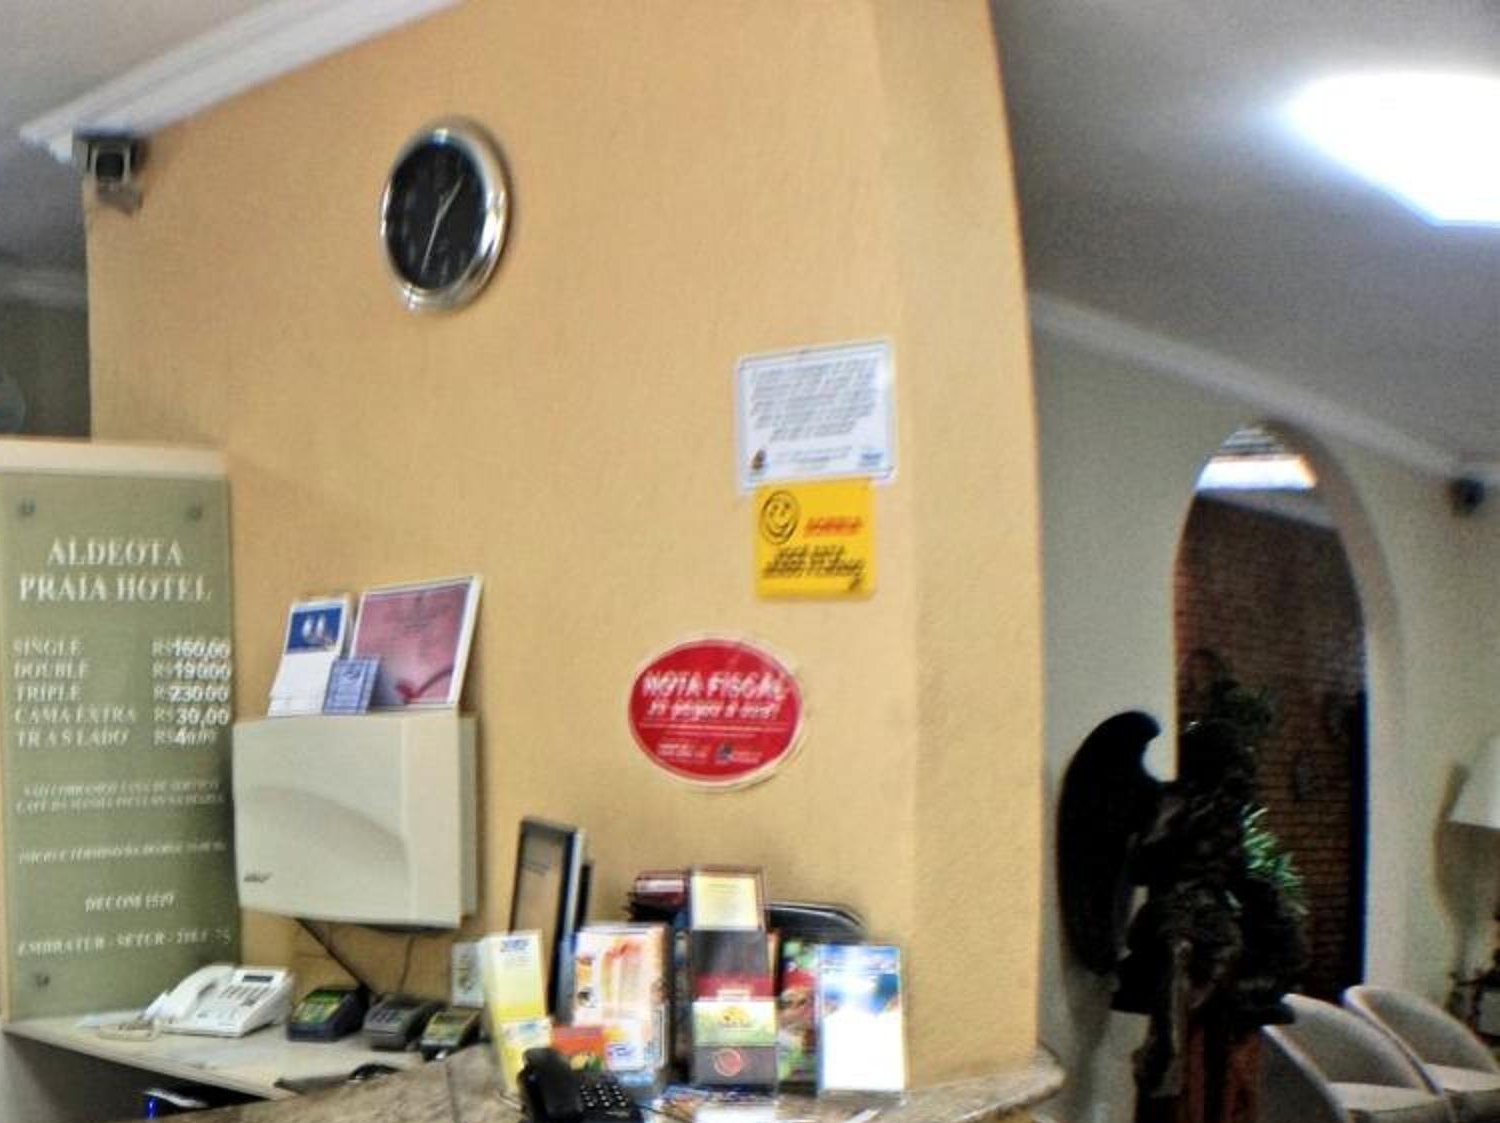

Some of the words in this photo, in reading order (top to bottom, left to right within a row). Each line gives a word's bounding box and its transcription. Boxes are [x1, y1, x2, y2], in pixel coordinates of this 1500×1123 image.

[48, 537, 182, 566] ALDEOTA
[19, 573, 108, 602] PRAIA
[116, 573, 212, 602] HOTEL
[13, 637, 82, 657] SINGLE
[14, 659, 89, 679] DOUBLE
[17, 682, 82, 701] TRIPLE
[643, 671, 701, 697] NOTA
